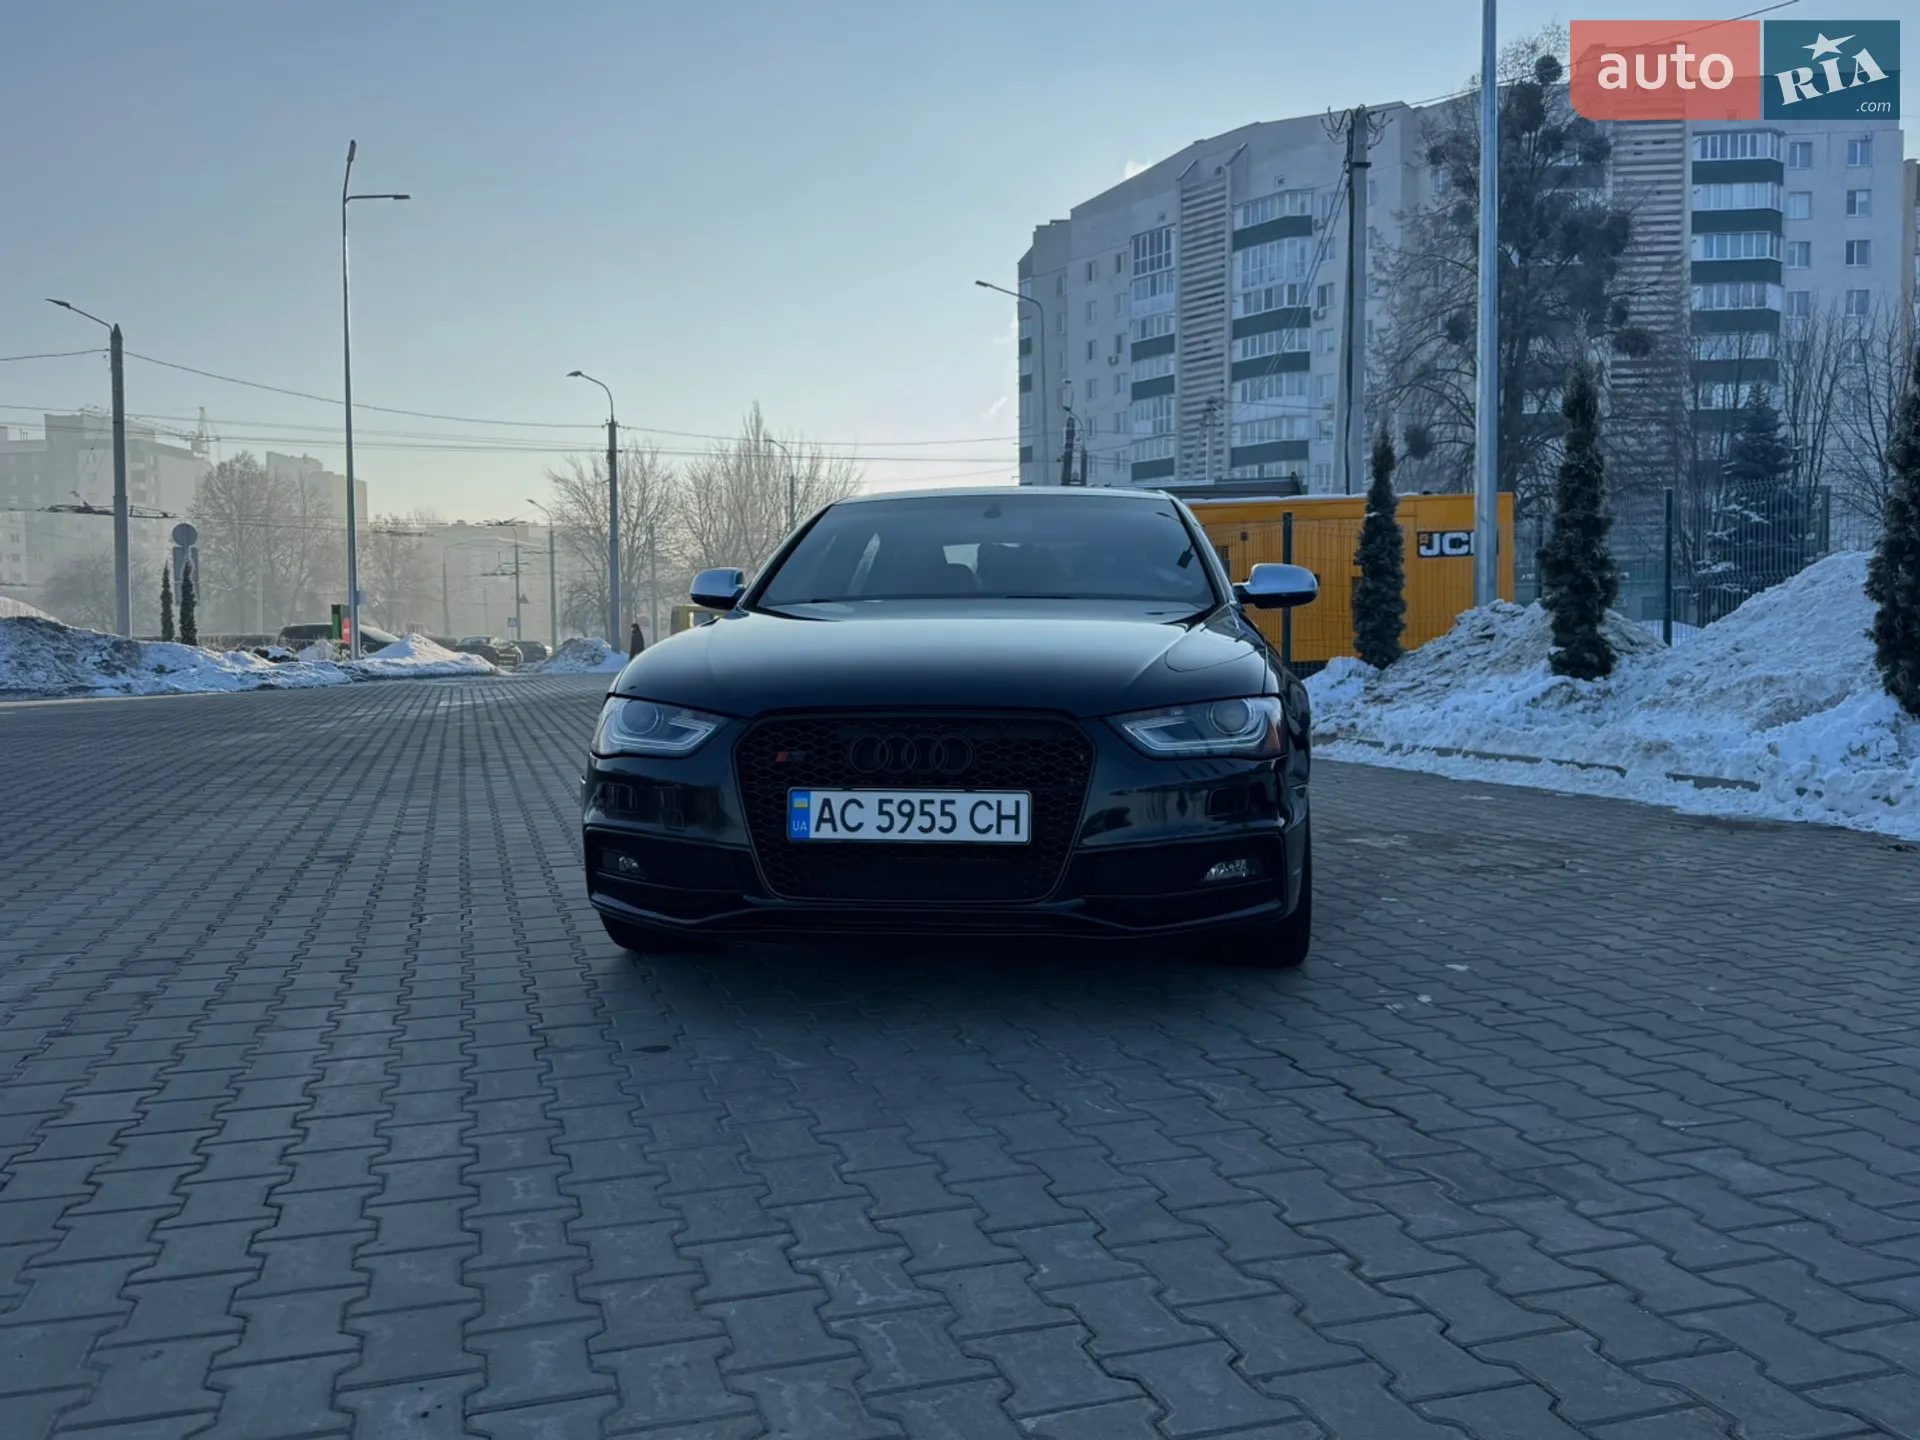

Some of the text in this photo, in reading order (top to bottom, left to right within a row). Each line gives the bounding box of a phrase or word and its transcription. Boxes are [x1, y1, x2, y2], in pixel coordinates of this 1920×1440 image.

[1419, 531, 1475, 556] JC
[792, 820, 808, 832] UA
[814, 798, 1021, 836] AC 5955 CH
